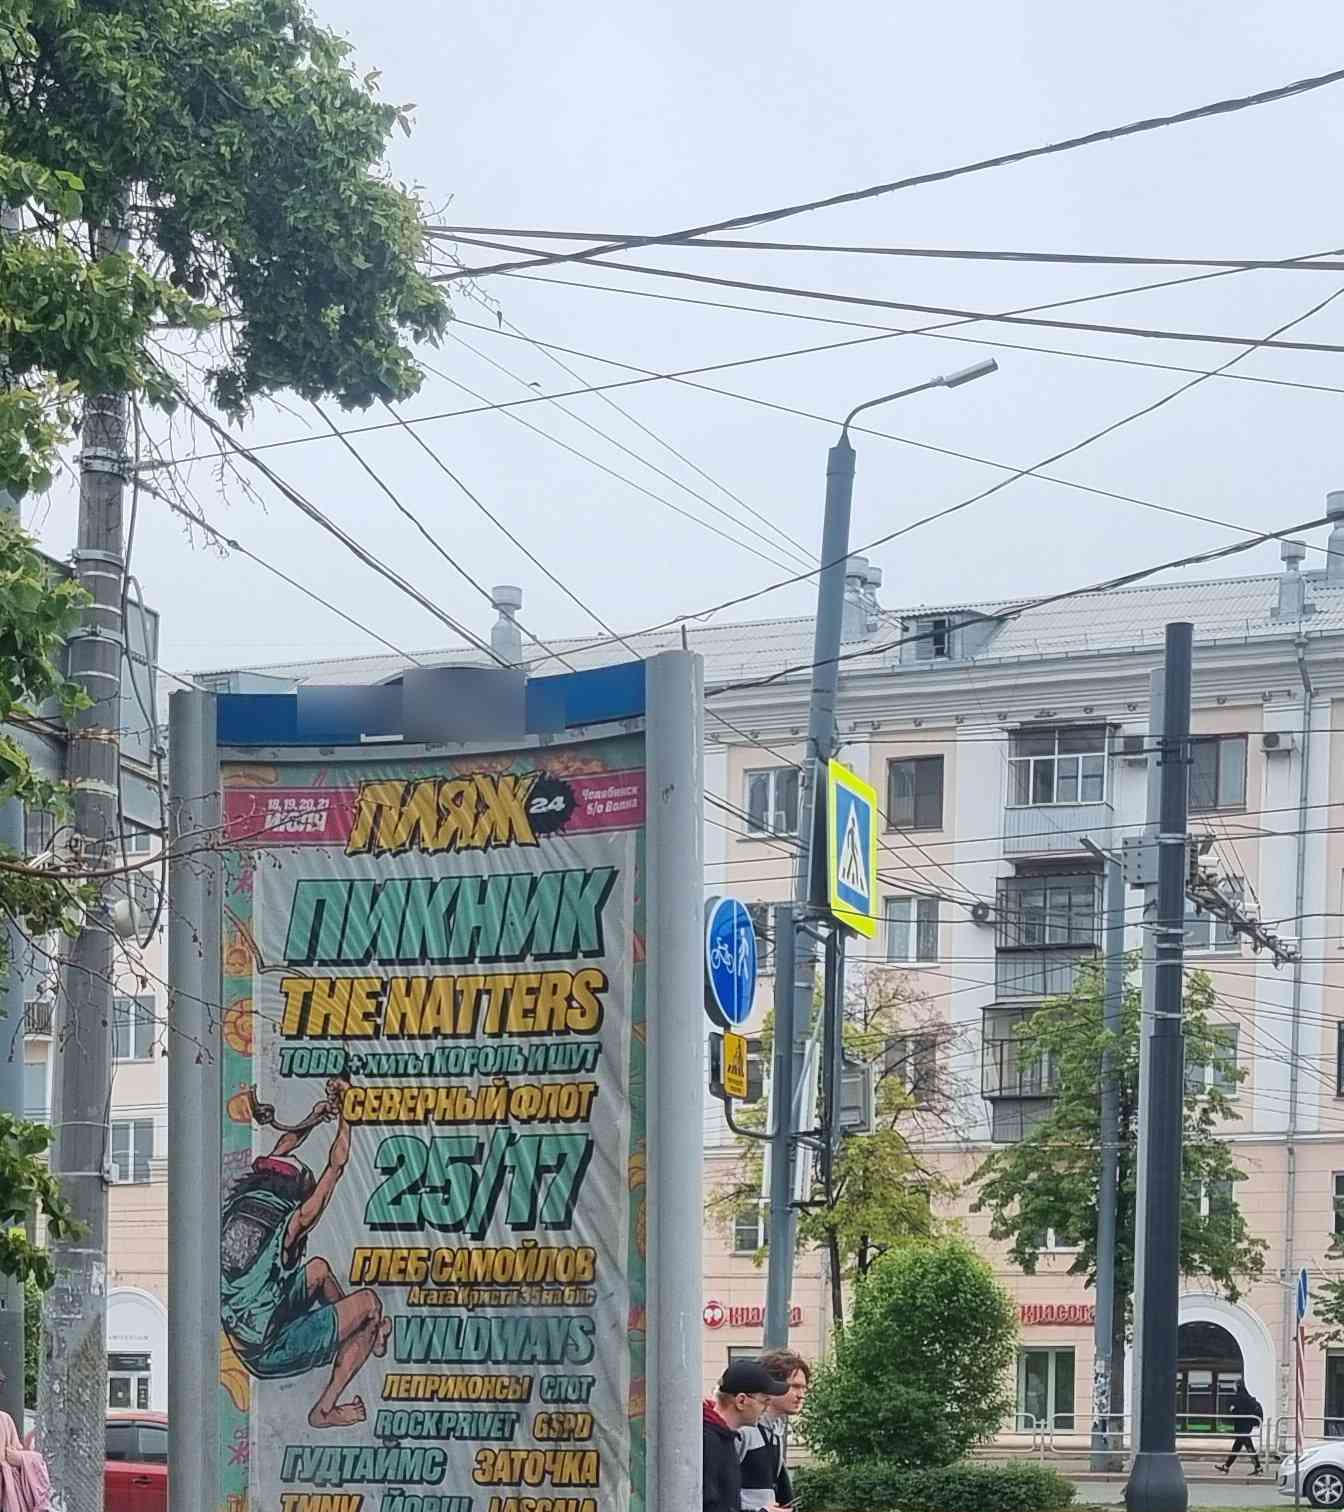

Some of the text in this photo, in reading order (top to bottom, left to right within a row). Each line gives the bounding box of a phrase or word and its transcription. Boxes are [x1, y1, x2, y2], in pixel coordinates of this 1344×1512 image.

[318, 799, 330, 809] 21
[344, 770, 542, 857] ПЛЯЖ
[529, 796, 565, 813] 24
[582, 786, 638, 800] Челябинск
[605, 799, 638, 813] Волна
[284, 866, 618, 966] ПИКНИК
[280, 968, 609, 1040] THE HATTERS
[279, 1047, 347, 1077] TODD
[348, 1054, 364, 1075] +
[433, 1045, 525, 1074] КОРОЛЬ
[526, 1045, 548, 1074] И
[548, 1042, 602, 1073] ШУТ
[342, 1077, 599, 1126] СЕВЕРНЫЙ ФЛОТ
[364, 1126, 594, 1241] 25/17
[349, 1239, 598, 1286] ГЛЕБ САМОЙЛОВ
[407, 1284, 597, 1311] Агата Кристи 35 на бис
[394, 1316, 596, 1364] WILDWAYS
[382, 1373, 595, 1404] ЛЕПРИКОНСЫ СЛОТ
[533, 1411, 594, 1441] GSPD
[280, 1440, 600, 1488] ГУДТАЙМС ЗАТОЧКА
